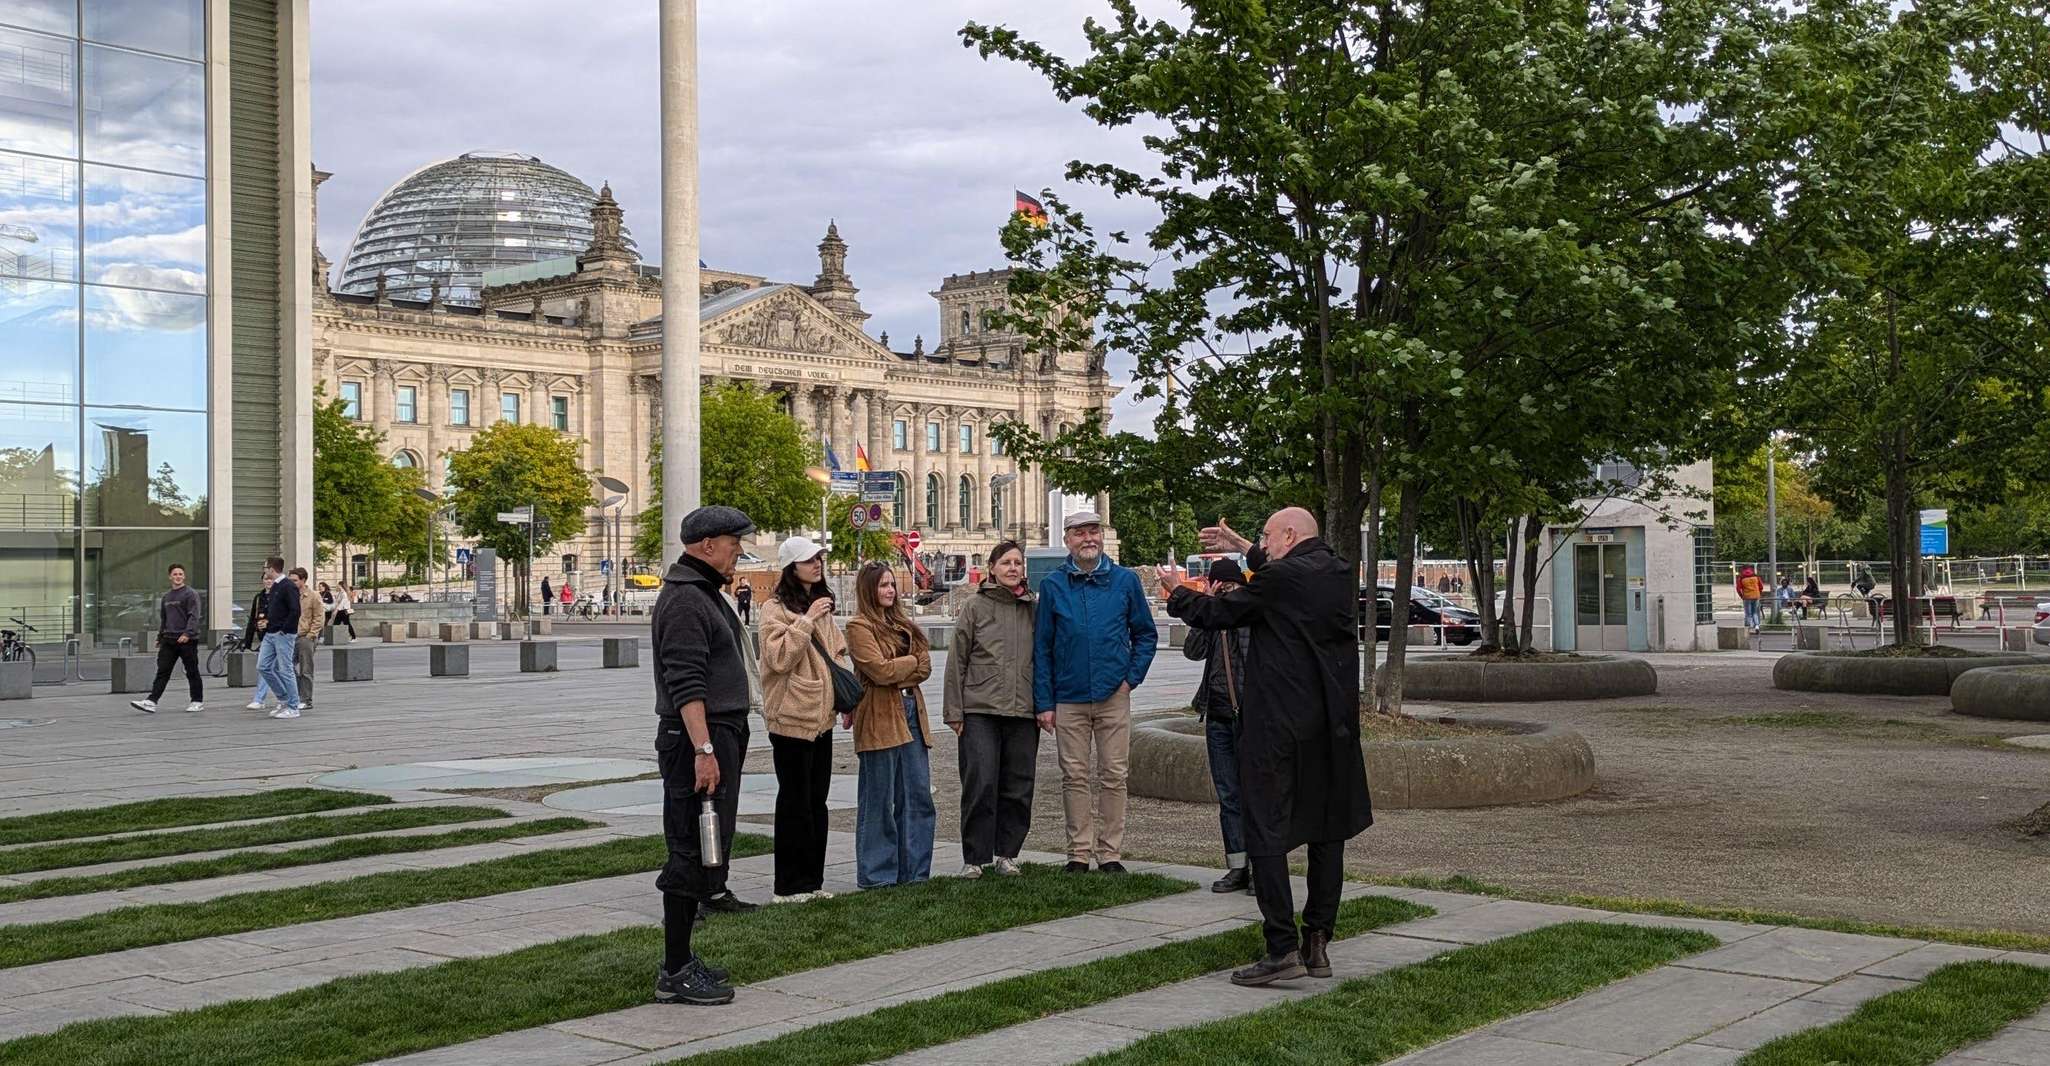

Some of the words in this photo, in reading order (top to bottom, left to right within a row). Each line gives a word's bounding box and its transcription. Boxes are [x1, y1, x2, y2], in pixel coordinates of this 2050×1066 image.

[734, 364, 752, 372] DEM
[758, 366, 802, 377] DEUTSCHEN
[807, 371, 830, 379] VOLKE
[854, 511, 864, 521] 50
